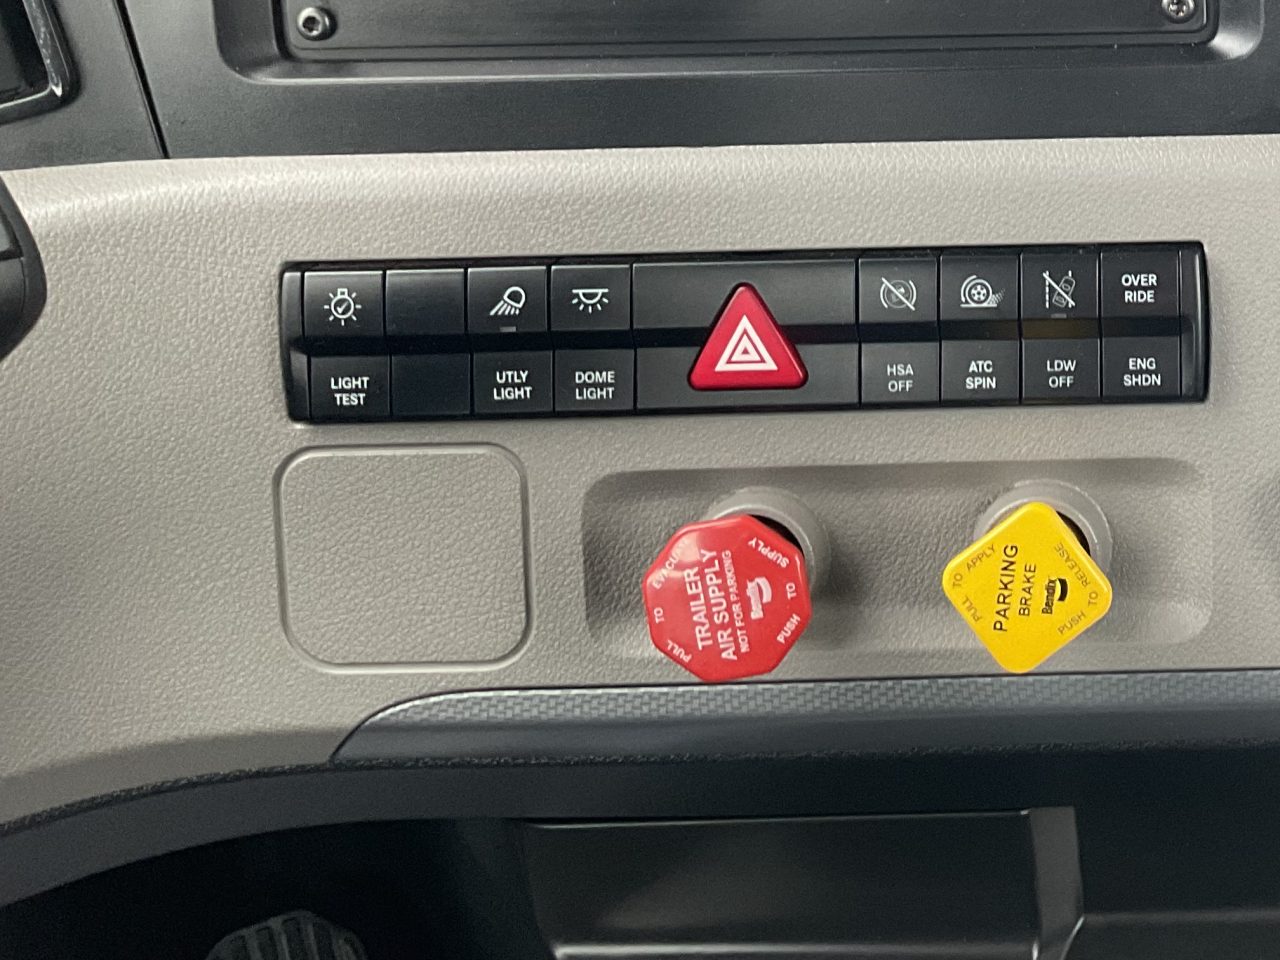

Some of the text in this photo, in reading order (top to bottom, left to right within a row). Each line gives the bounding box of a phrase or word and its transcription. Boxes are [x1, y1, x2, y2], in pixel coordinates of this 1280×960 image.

[1121, 273, 1157, 287] OVER
[1124, 290, 1155, 303] RIDE
[887, 363, 914, 377] HSA
[968, 360, 993, 373] ATC
[1046, 359, 1077, 372] LDW
[1128, 357, 1156, 370] ENG
[330, 376, 370, 392] LIGHT
[495, 370, 529, 384] UTLY
[575, 370, 615, 384] DOME
[965, 376, 996, 390] SPIN
[1048, 375, 1074, 388] OFF
[1123, 373, 1161, 387] SHDN
[493, 386, 532, 401] LIGHT
[575, 386, 615, 400] LIGHT
[888, 380, 913, 393] OFF
[334, 392, 366, 406] TEST
[748, 537, 790, 569] SUPPLY
[952, 544, 996, 623] PULL TO APPLY
[993, 544, 1019, 632] PARKING
[1018, 563, 1037, 617] BRAKE
[1054, 542, 1099, 635] PUSH TO RELEASE
[786, 582, 797, 600] TO
[701, 548, 738, 661] AIR SUPPLY
[721, 549, 750, 653] NOT FOR PARKING
[653, 607, 664, 624] TO
[683, 566, 713, 651] TRAILER
[776, 613, 801, 644] PUSH
[667, 639, 693, 663] PULL
